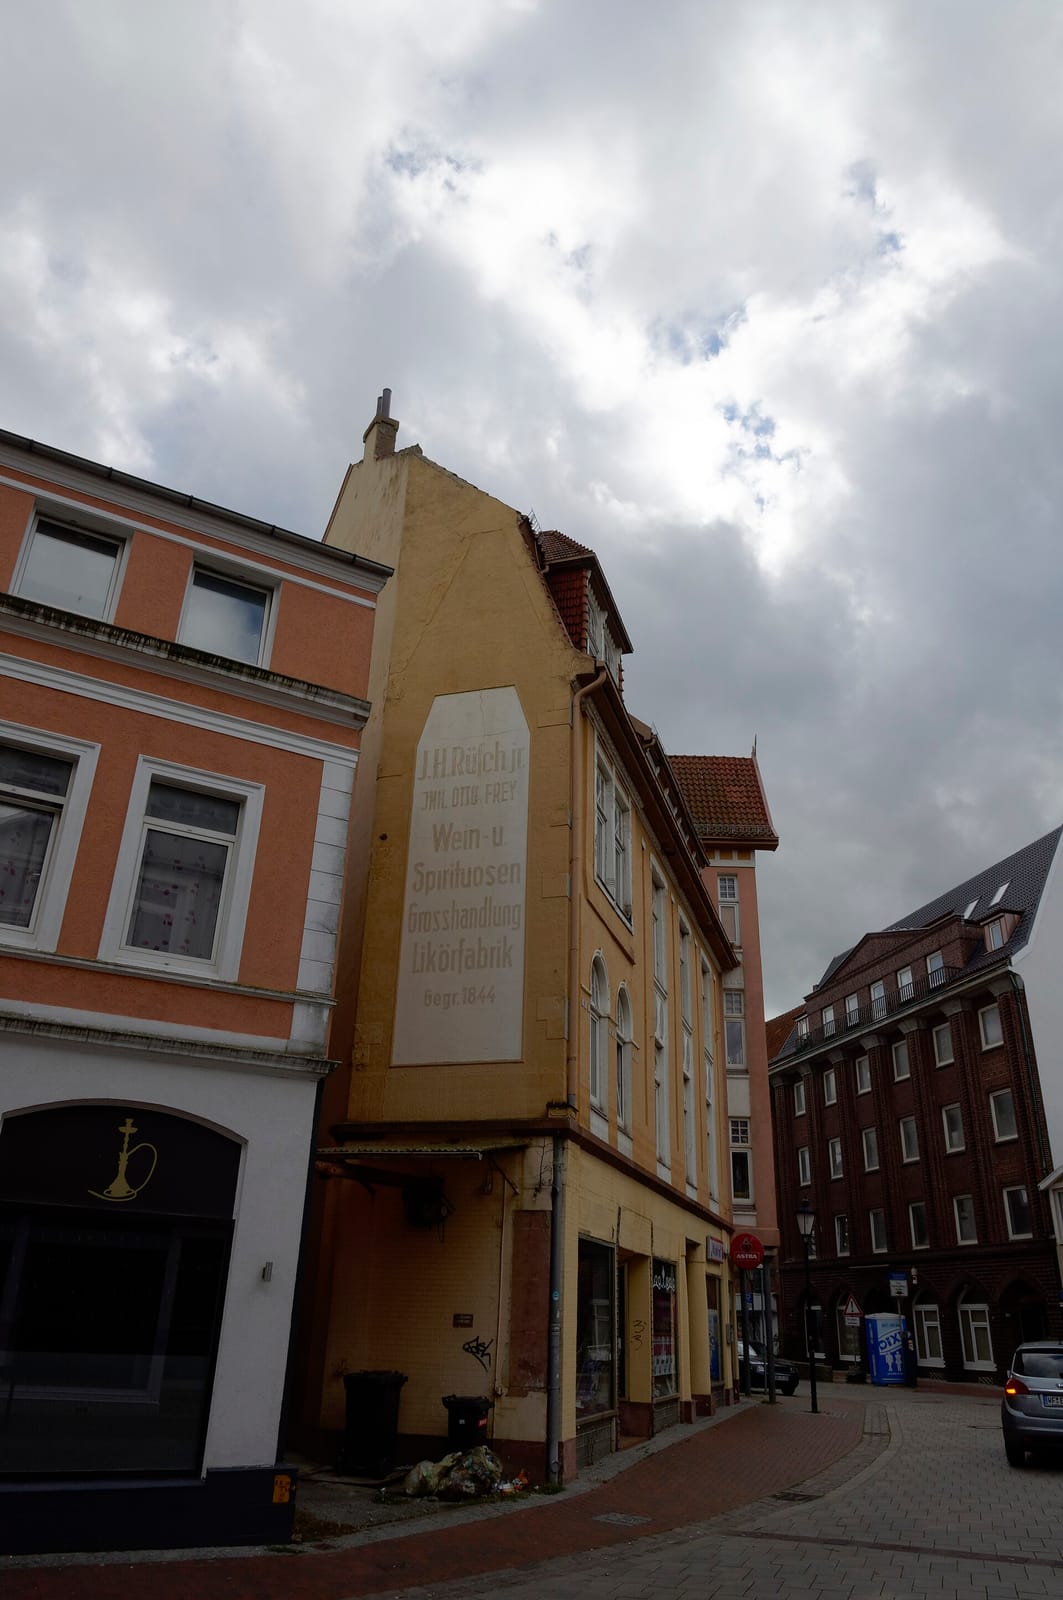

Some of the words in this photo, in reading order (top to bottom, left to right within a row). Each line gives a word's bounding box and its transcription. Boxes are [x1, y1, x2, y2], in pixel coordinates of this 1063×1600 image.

[485, 779, 518, 805] FREY
[413, 860, 521, 896] Spirituosen
[407, 896, 521, 933] Grosshandlung
[411, 936, 513, 974] Likörfabrik
